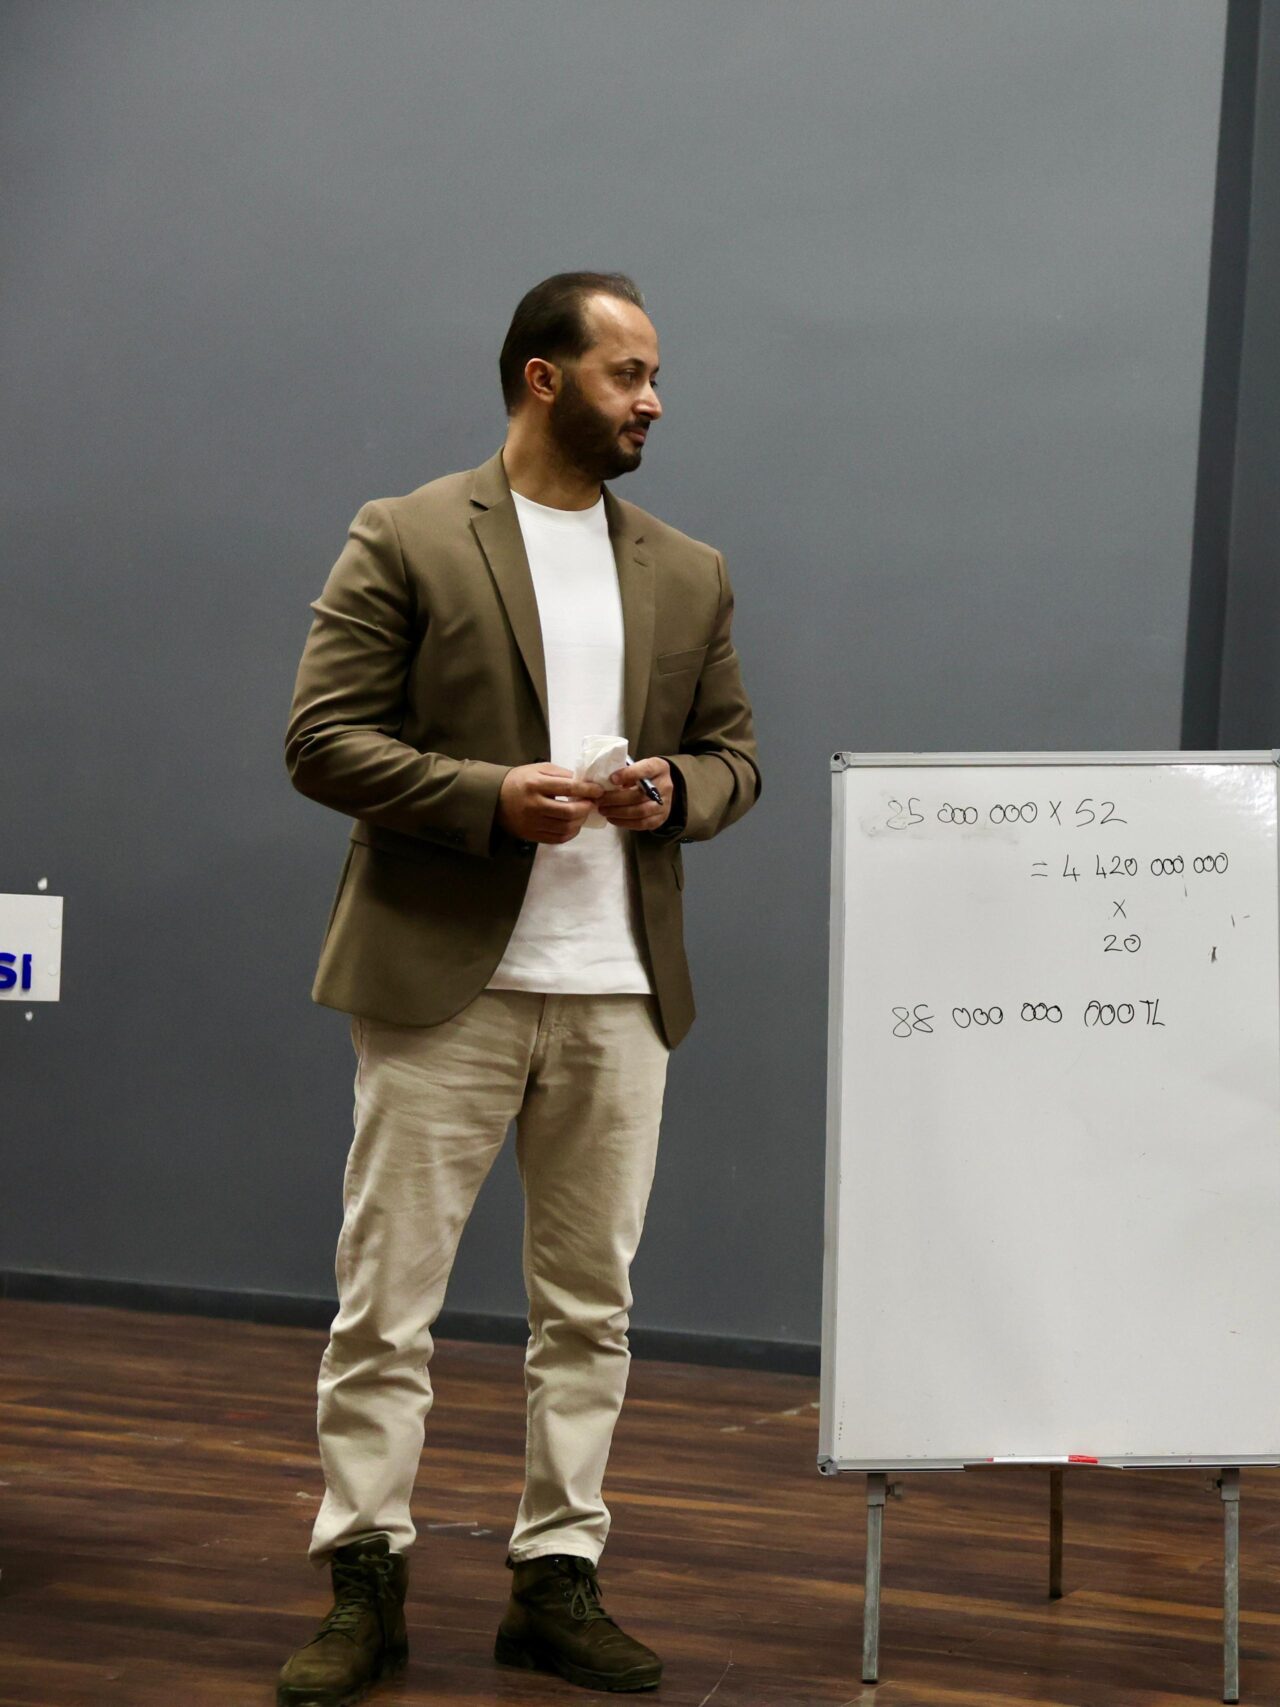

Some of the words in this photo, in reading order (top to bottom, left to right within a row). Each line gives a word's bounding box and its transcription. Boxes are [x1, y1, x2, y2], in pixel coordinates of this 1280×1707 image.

[1075, 798, 1128, 828] 52
[1062, 854, 1081, 882] 4
[1095, 854, 1139, 880] 420
[1103, 933, 1142, 953] 20
[891, 1004, 934, 1038] 88
